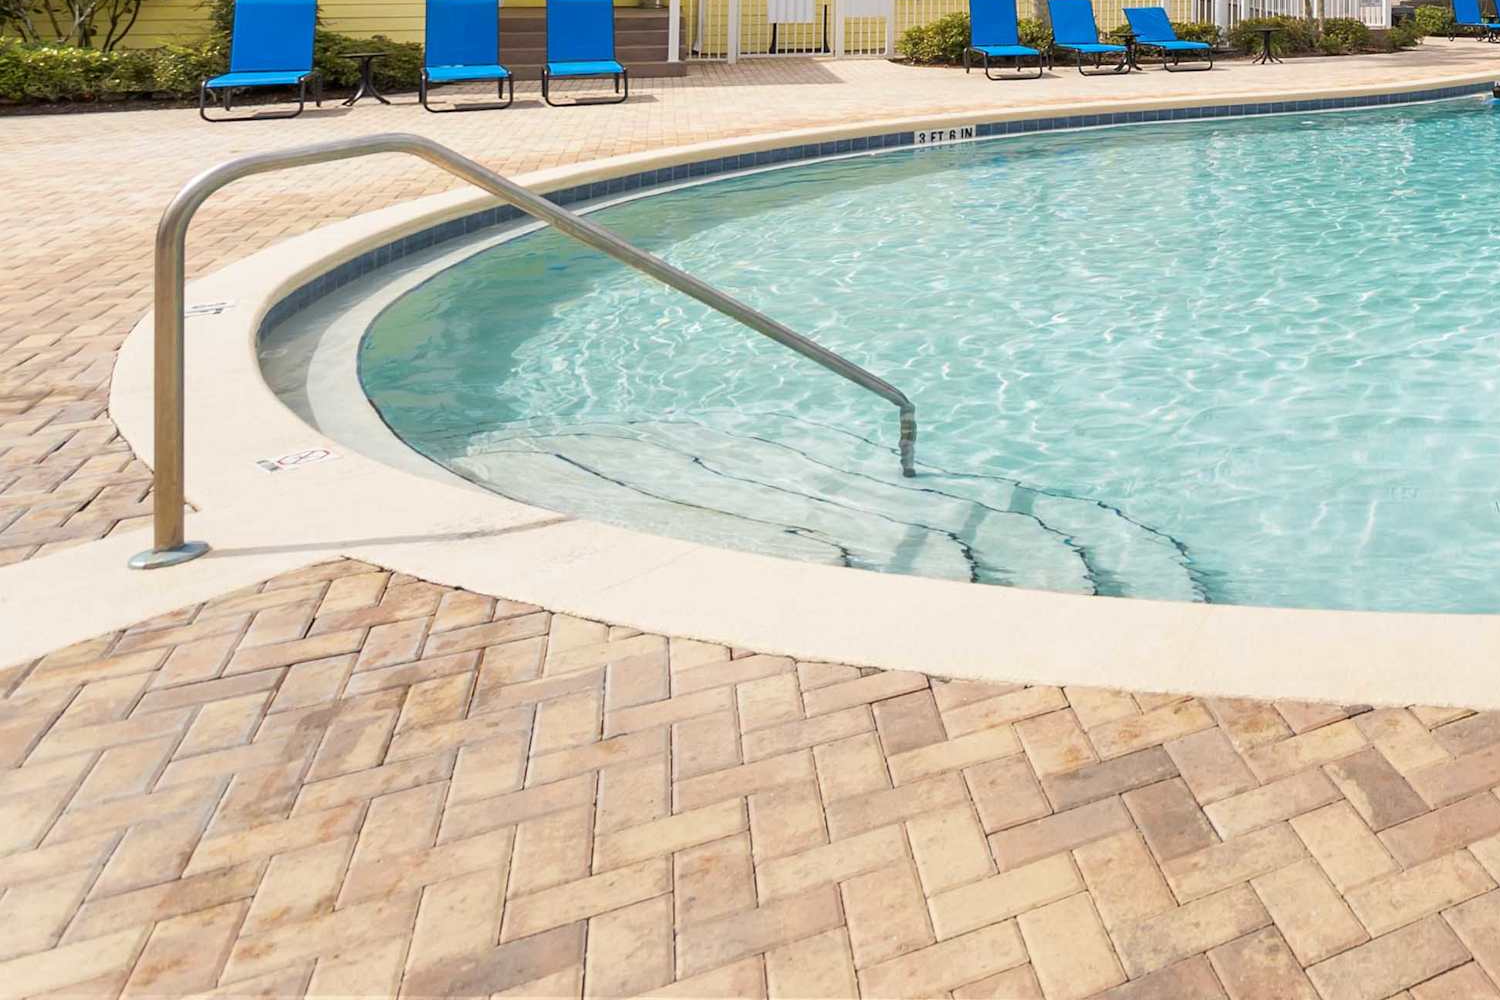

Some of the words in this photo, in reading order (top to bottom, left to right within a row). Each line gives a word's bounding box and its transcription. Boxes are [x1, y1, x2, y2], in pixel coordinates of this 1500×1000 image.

[919, 133, 926, 144] 3
[930, 131, 944, 142] FT
[961, 127, 973, 139] IN
